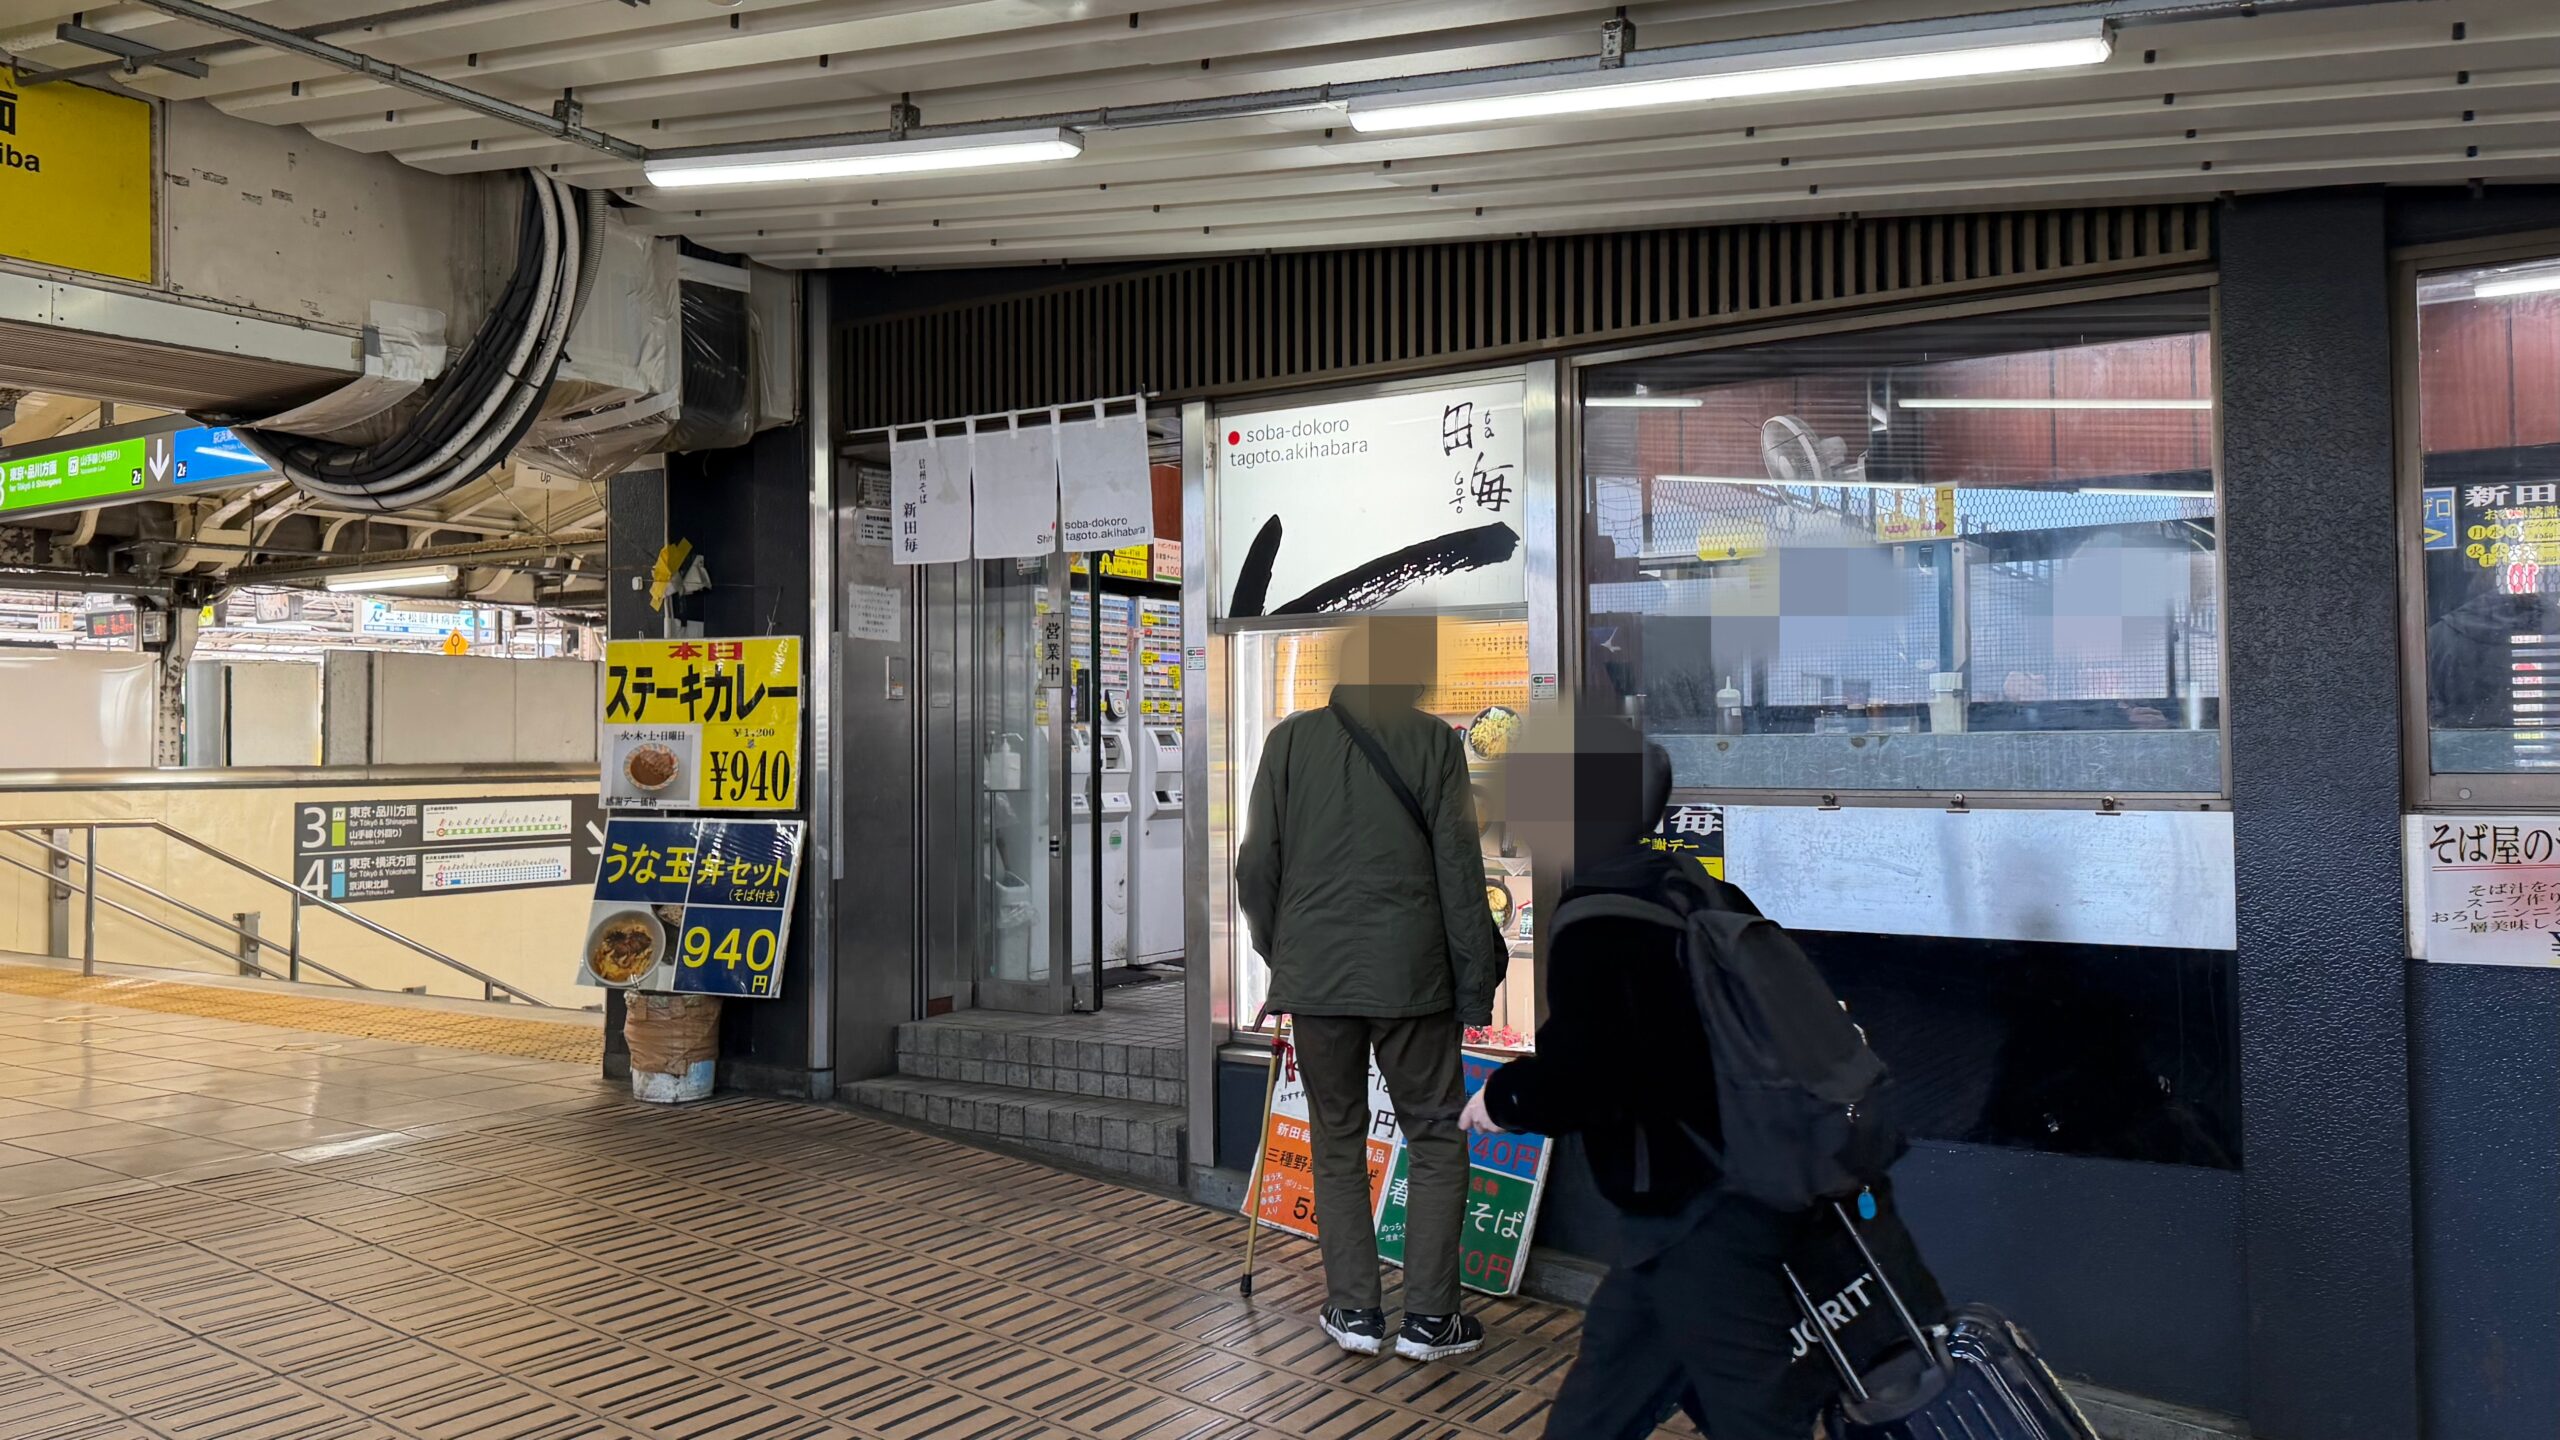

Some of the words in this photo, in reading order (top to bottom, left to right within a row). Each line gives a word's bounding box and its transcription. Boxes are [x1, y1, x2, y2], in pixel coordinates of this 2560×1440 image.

[1246, 417, 1349, 444] soba-dokoro
[1230, 438, 1368, 468] tagoto.akihabara
[541, 472, 551, 484] Up
[904, 502, 918, 553] 新田毎
[1064, 517, 1128, 529] soba-dokoro
[1065, 526, 1146, 541] tagoto.akihabara
[668, 641, 743, 662] 本日
[1046, 622, 1060, 682] 営業中
[606, 663, 797, 722] ステーキカレー
[620, 730, 686, 742] 火・木・土・日曜日
[710, 750, 791, 801] ¥940
[302, 807, 327, 848] 3
[349, 804, 417, 818] 東京・品川方面
[2429, 823, 2560, 865] そば屋の
[349, 855, 417, 869] 東京・横浜方面
[606, 842, 791, 887] うな玉丼セット
[300, 859, 328, 899] 4
[682, 926, 777, 972] 940
[752, 975, 768, 993] 円
[1470, 1202, 1526, 1239] そば
